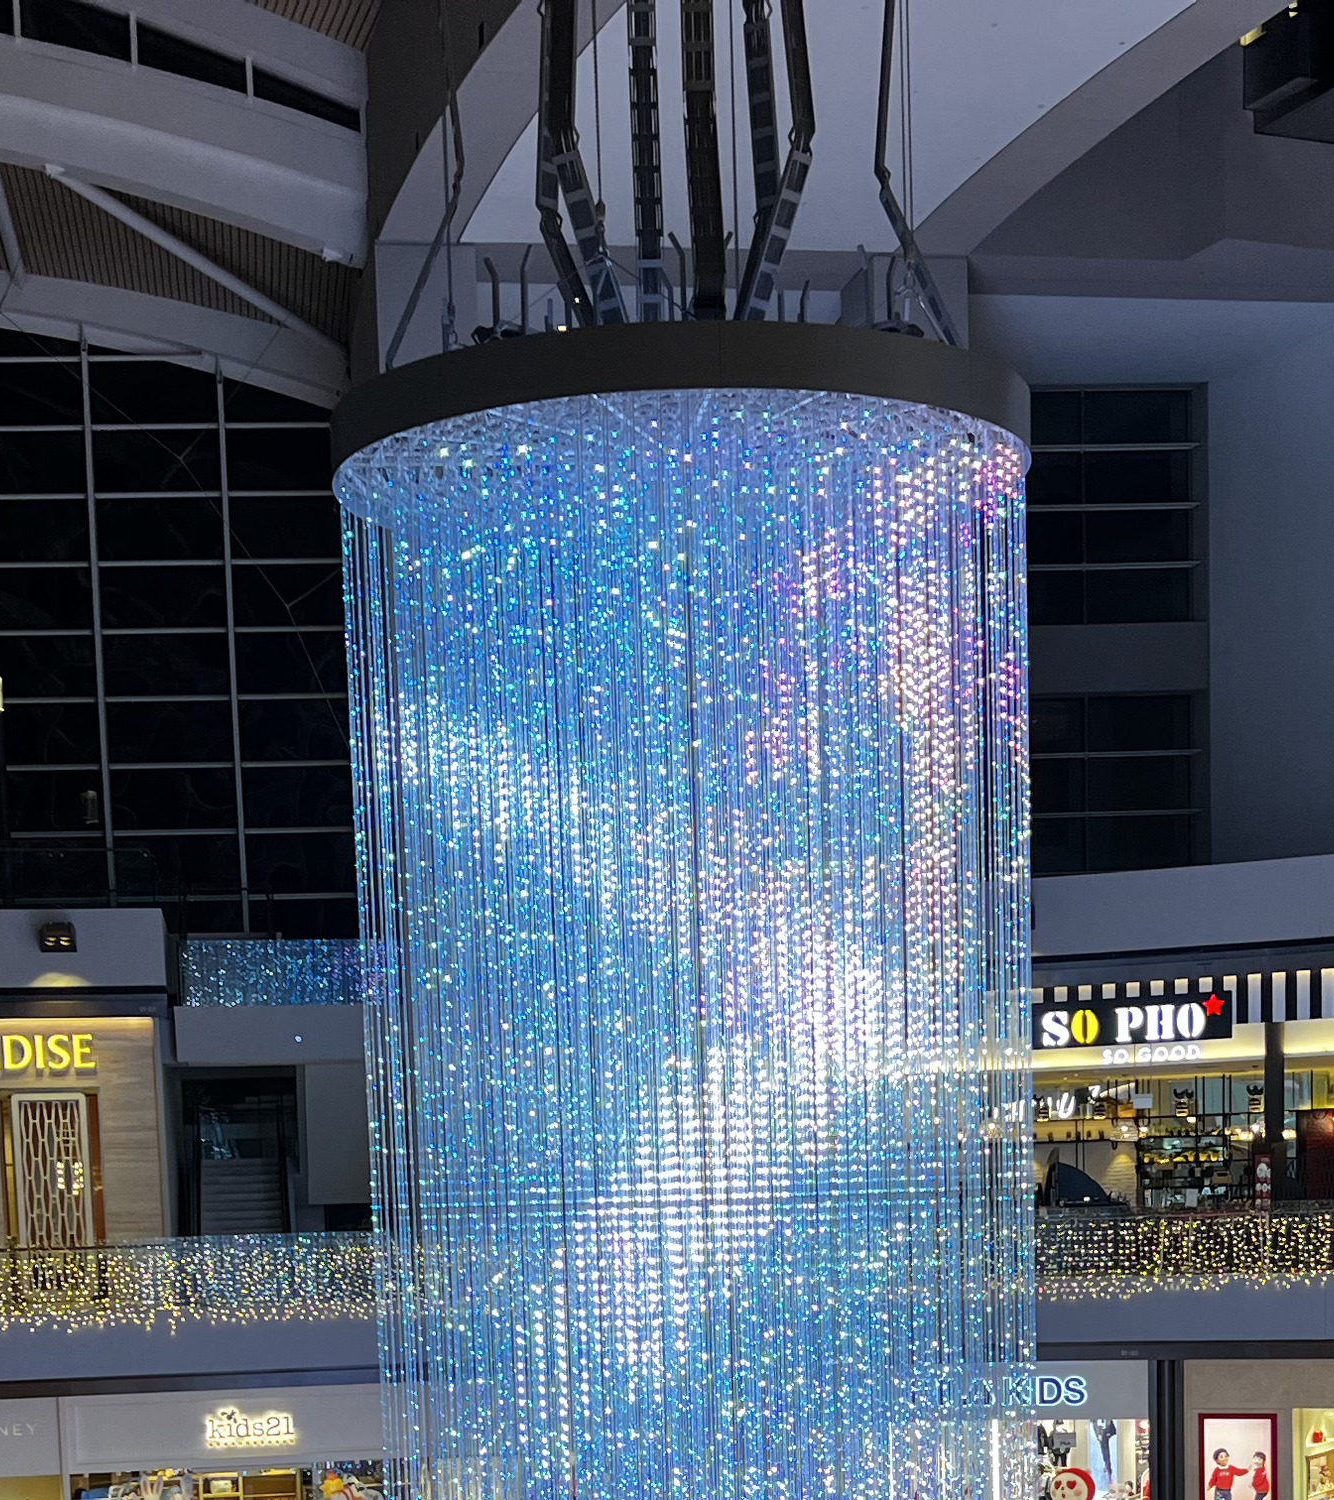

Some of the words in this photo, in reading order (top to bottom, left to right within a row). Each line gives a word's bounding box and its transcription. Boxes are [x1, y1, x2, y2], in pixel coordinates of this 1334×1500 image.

[1042, 1009, 1099, 1047] SO
[1115, 1002, 1206, 1042] PHO
[1102, 1048, 1130, 1065] SO
[1136, 1045, 1202, 1063] GOOD
[1002, 1376, 1088, 1407] KIDS
[208, 1416, 295, 1439] kids21
